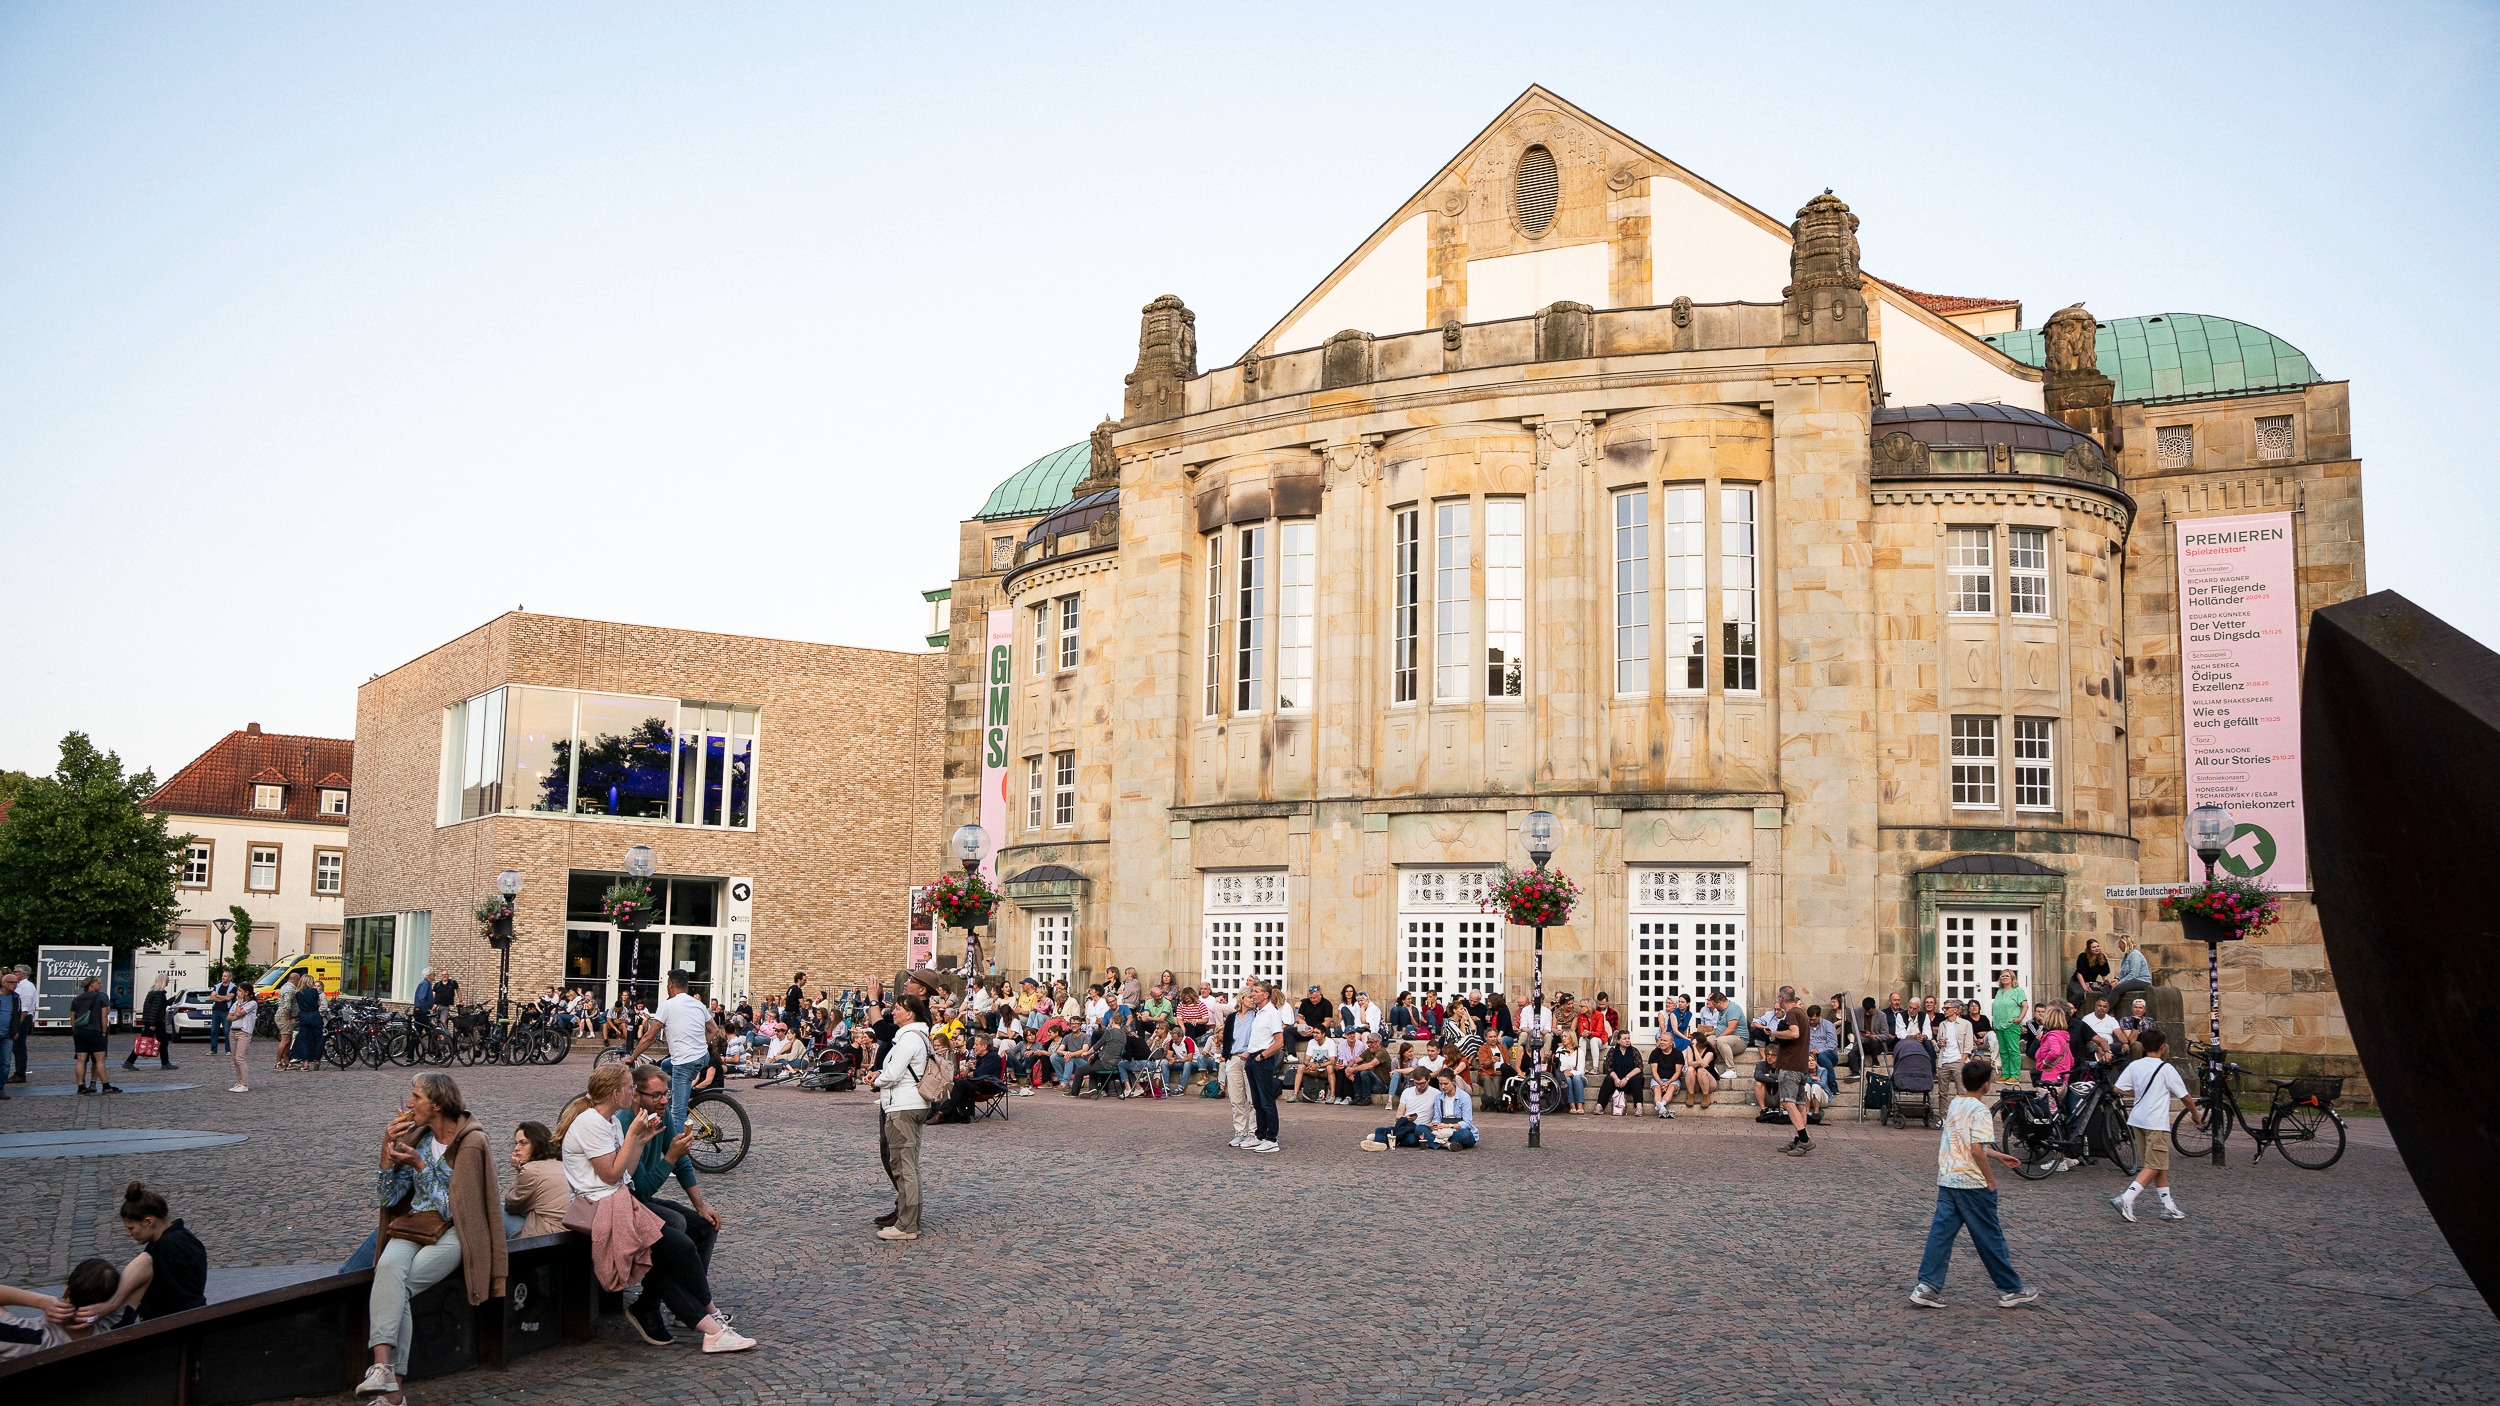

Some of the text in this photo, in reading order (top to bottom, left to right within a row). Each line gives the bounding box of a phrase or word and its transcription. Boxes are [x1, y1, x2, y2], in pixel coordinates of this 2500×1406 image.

[2185, 529, 2283, 546] PREMIEREN
[2185, 546, 2246, 557] Spielzeitstart
[2189, 583, 2266, 596] Der Fliegende
[2189, 595, 2244, 606] Holländer
[2190, 620, 2246, 630] Der Vetter
[2190, 633, 2210, 642] aus
[2214, 630, 2260, 641] Dingsda
[2192, 651, 2226, 660] Schauspiel
[991, 645, 1012, 686] G
[2192, 670, 2232, 681] Ödipus
[2192, 682, 2244, 692] Exzellenz
[2193, 708, 2214, 716] Wie
[2194, 719, 2220, 728] euch
[2224, 717, 2258, 728] gefällt
[988, 728, 1008, 768] S
[2195, 756, 2208, 766] All
[2232, 755, 2271, 764] Stories
[2206, 799, 2295, 810] Sinfoniekonzert
[2106, 888, 2124, 897] Platz
[2126, 888, 2138, 896] der
[914, 937, 929, 945] BEACH
[47, 960, 89, 968] Getränke
[48, 966, 102, 976] Weidlich
